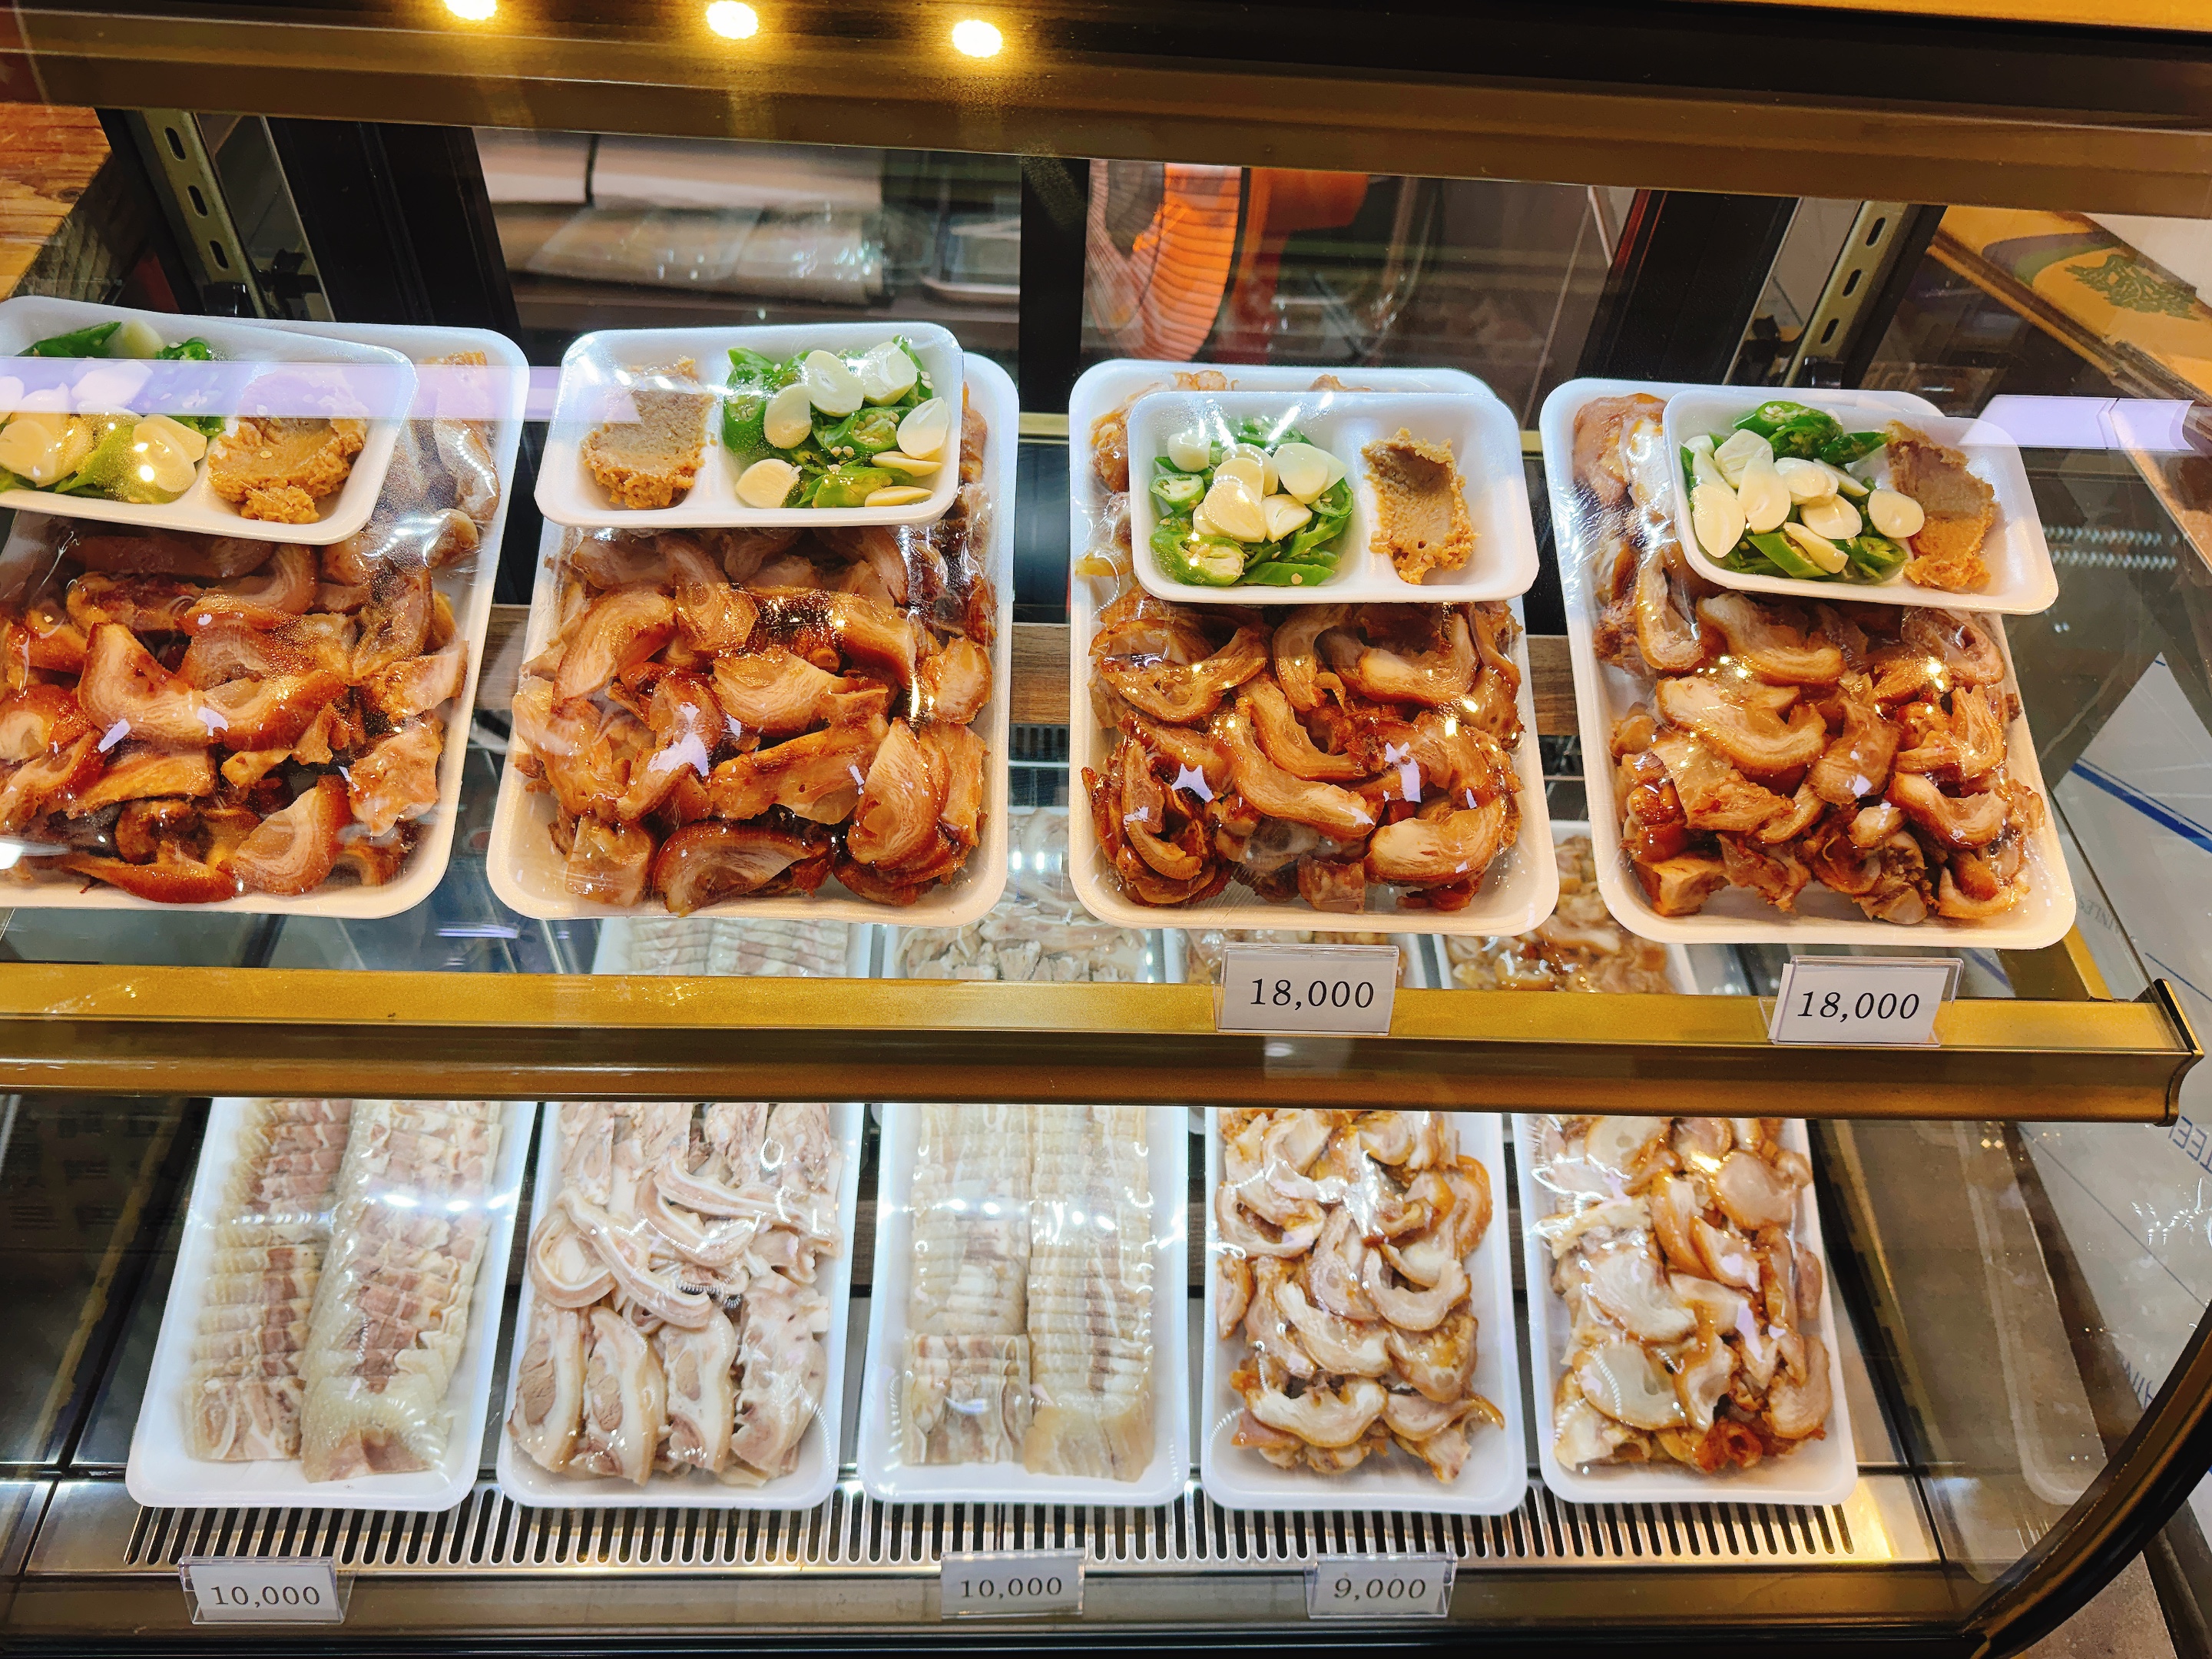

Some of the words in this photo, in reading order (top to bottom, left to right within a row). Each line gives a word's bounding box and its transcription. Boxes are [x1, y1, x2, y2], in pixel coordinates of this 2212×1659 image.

[1250, 978, 1374, 1011] 18,000
[1797, 991, 1919, 1023] 18,000
[210, 1586, 320, 1608] 10,000
[961, 1576, 1062, 1599] 10,000
[1334, 1577, 1426, 1601] 9,000
